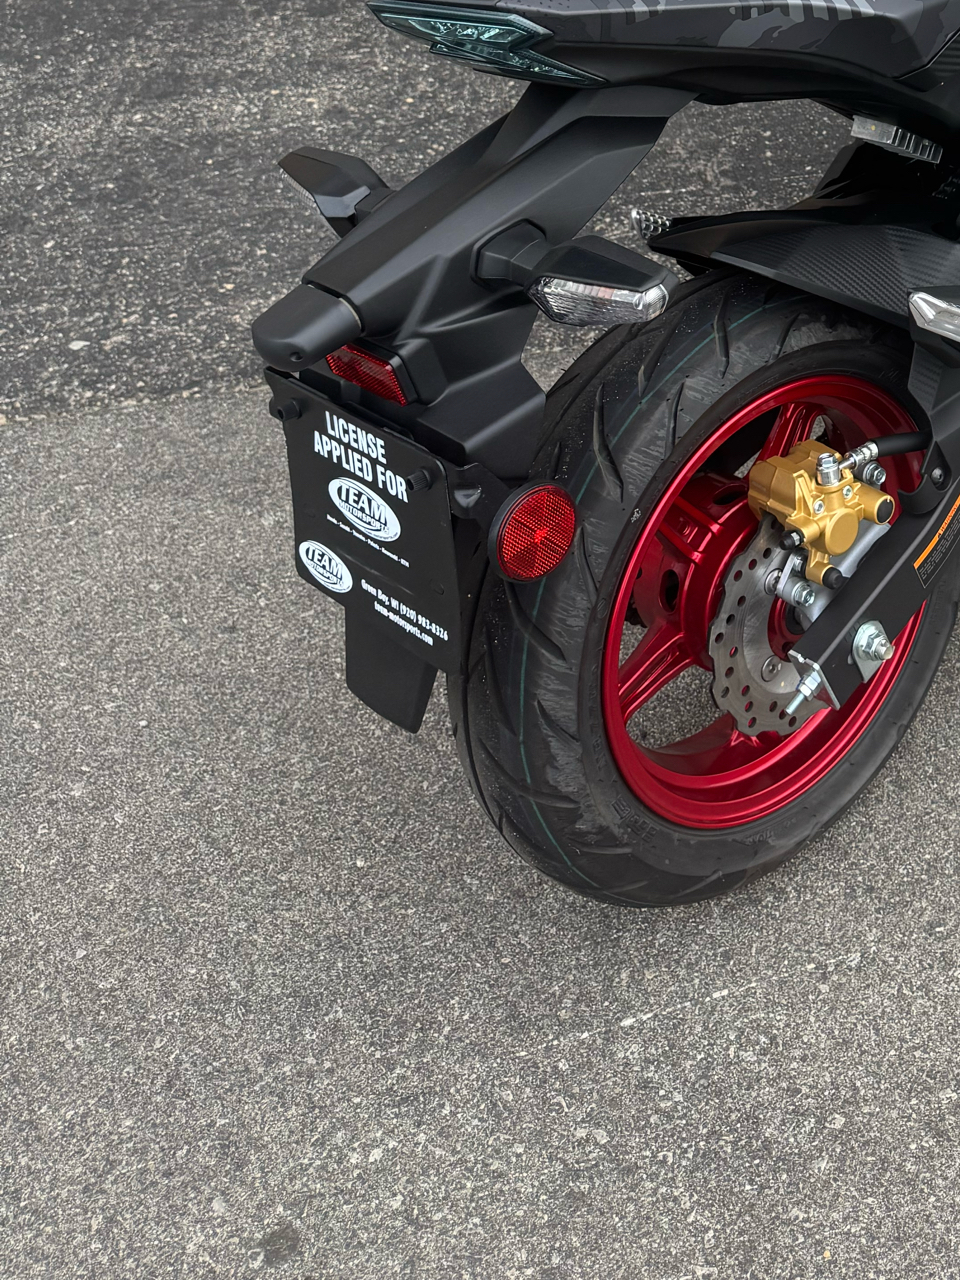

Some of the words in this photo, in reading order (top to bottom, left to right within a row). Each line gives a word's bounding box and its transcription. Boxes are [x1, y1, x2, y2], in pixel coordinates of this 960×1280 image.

[325, 410, 387, 464] LICENSE
[314, 430, 373, 482] APPLIED
[376, 464, 409, 503] FOR
[337, 484, 388, 525] TEAM
[338, 500, 390, 535] MOTORSPORTS
[305, 546, 343, 580] TEAM
[390, 597, 400, 611] WI
[417, 614, 449, 641] 983-8326
